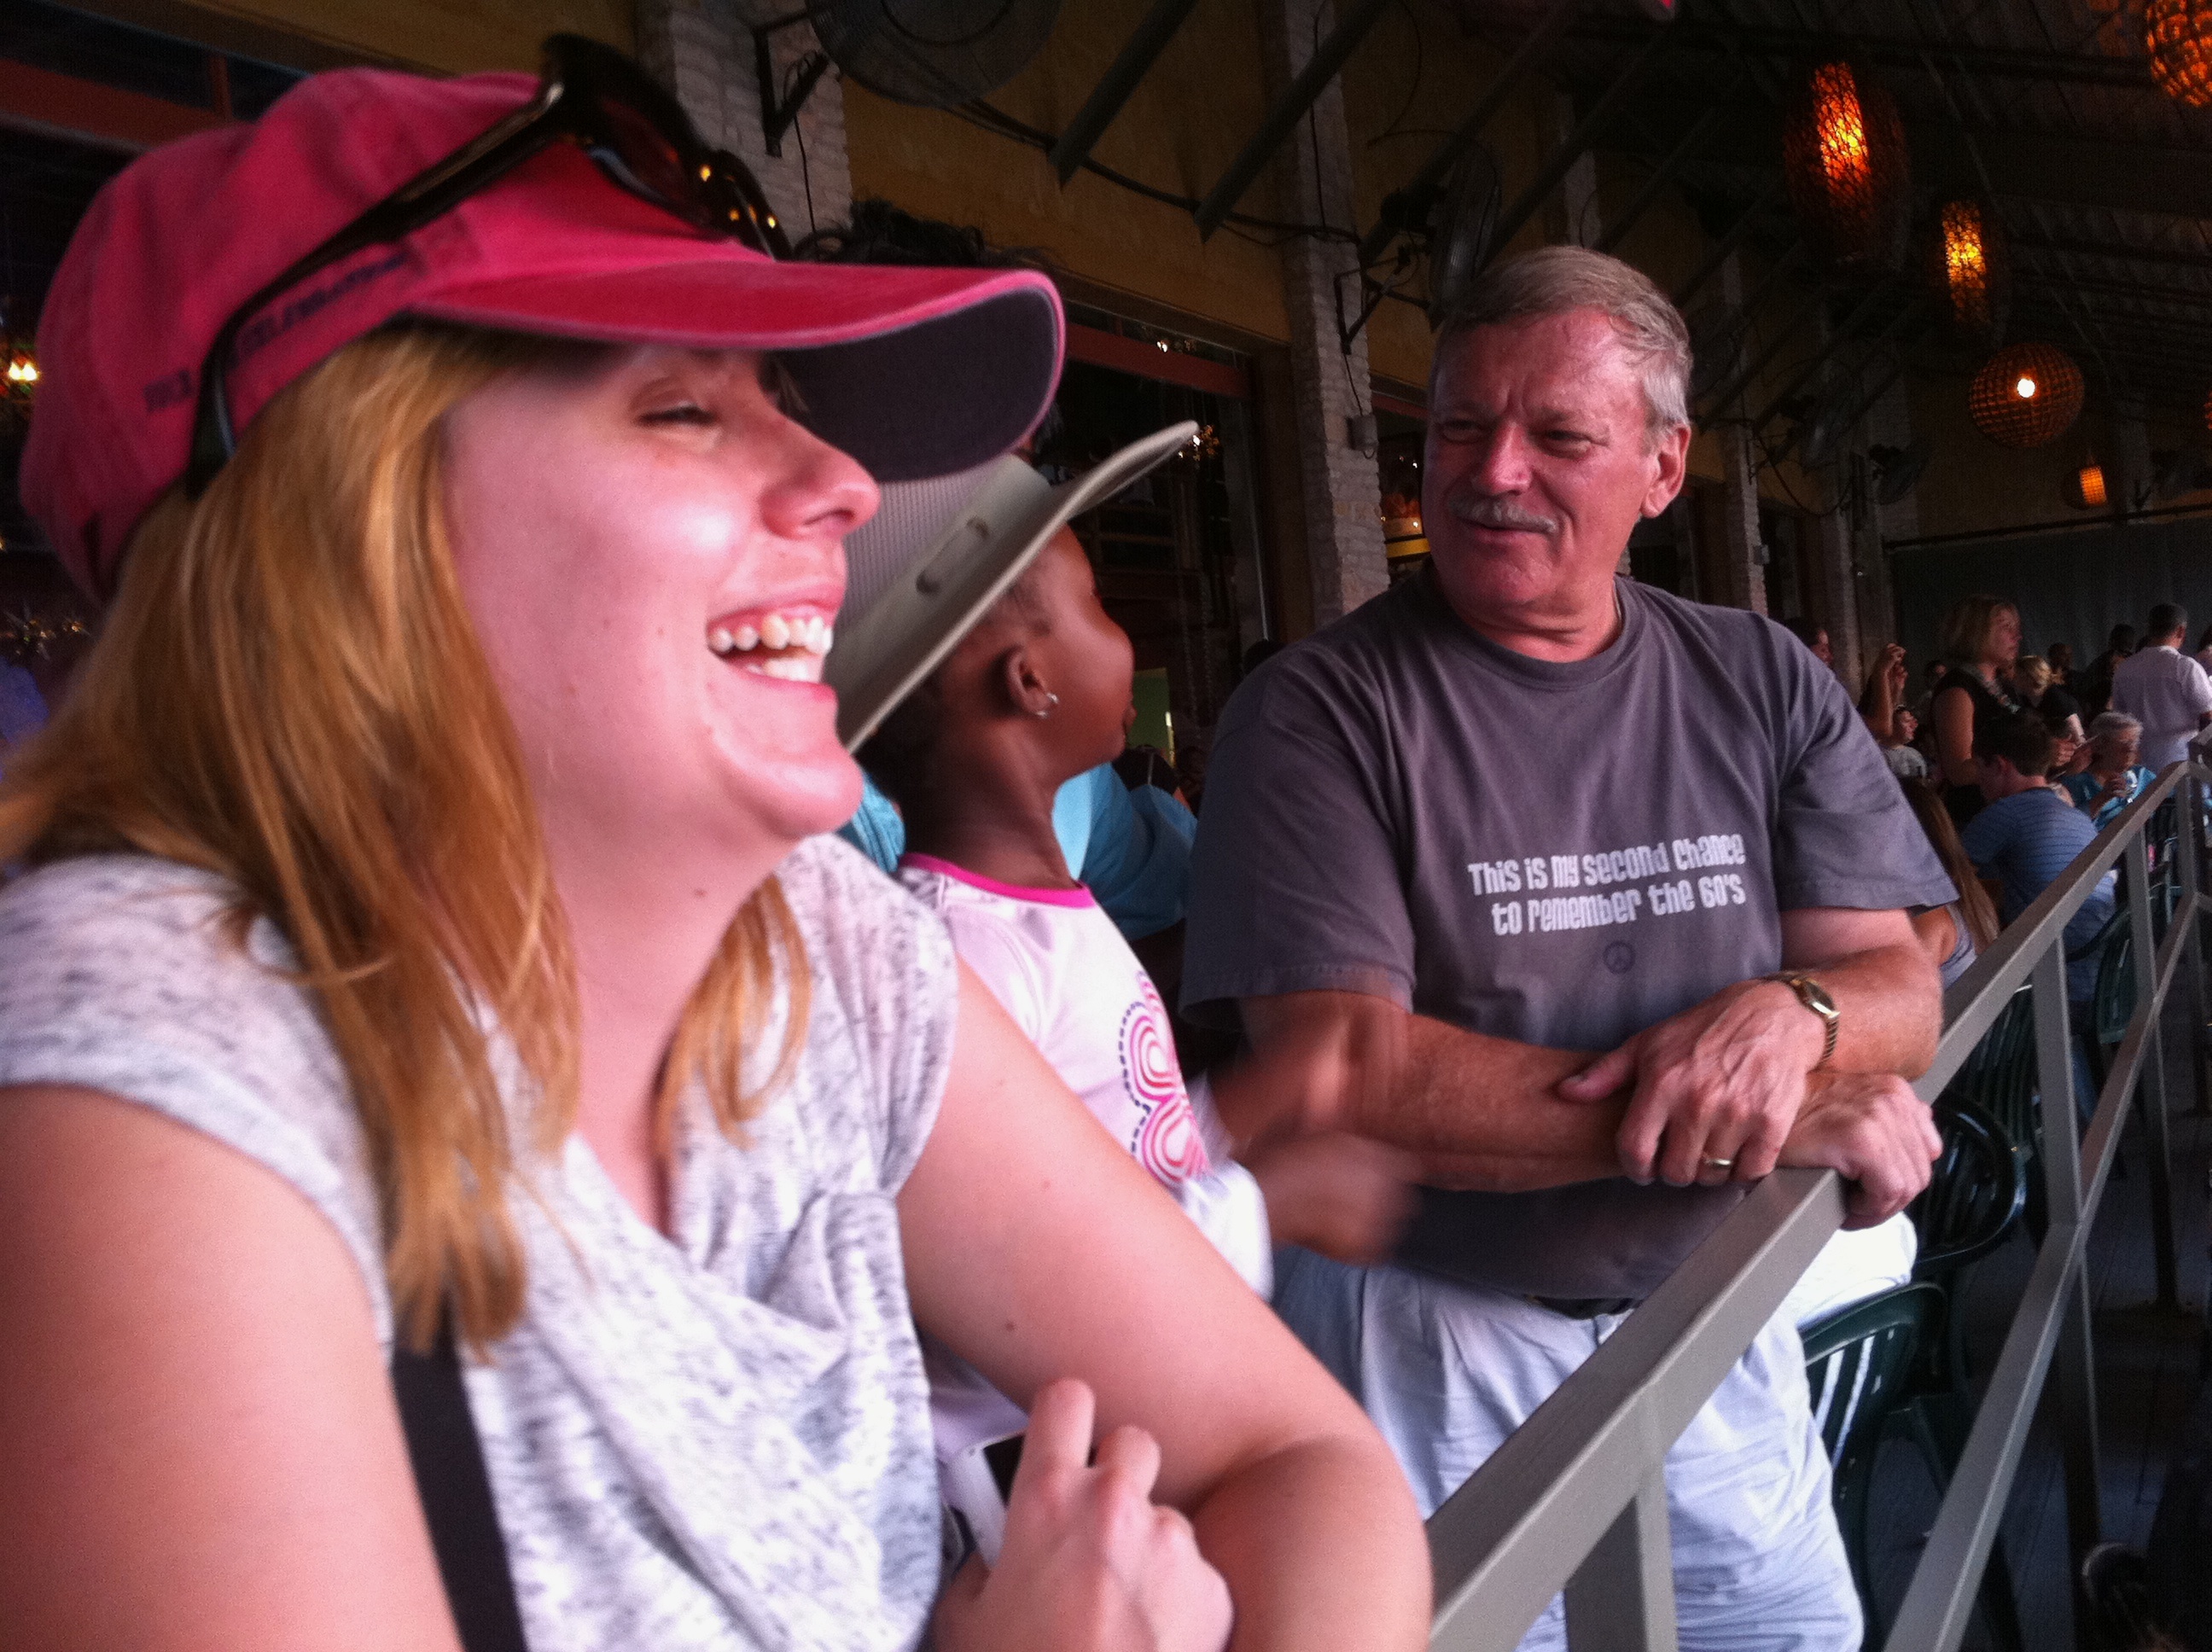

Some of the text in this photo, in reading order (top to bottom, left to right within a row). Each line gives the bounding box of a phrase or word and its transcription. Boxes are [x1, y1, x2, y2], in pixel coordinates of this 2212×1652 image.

[1468, 834, 1746, 896] This is my second chance
[1493, 874, 1746, 935] to remember the 60's
